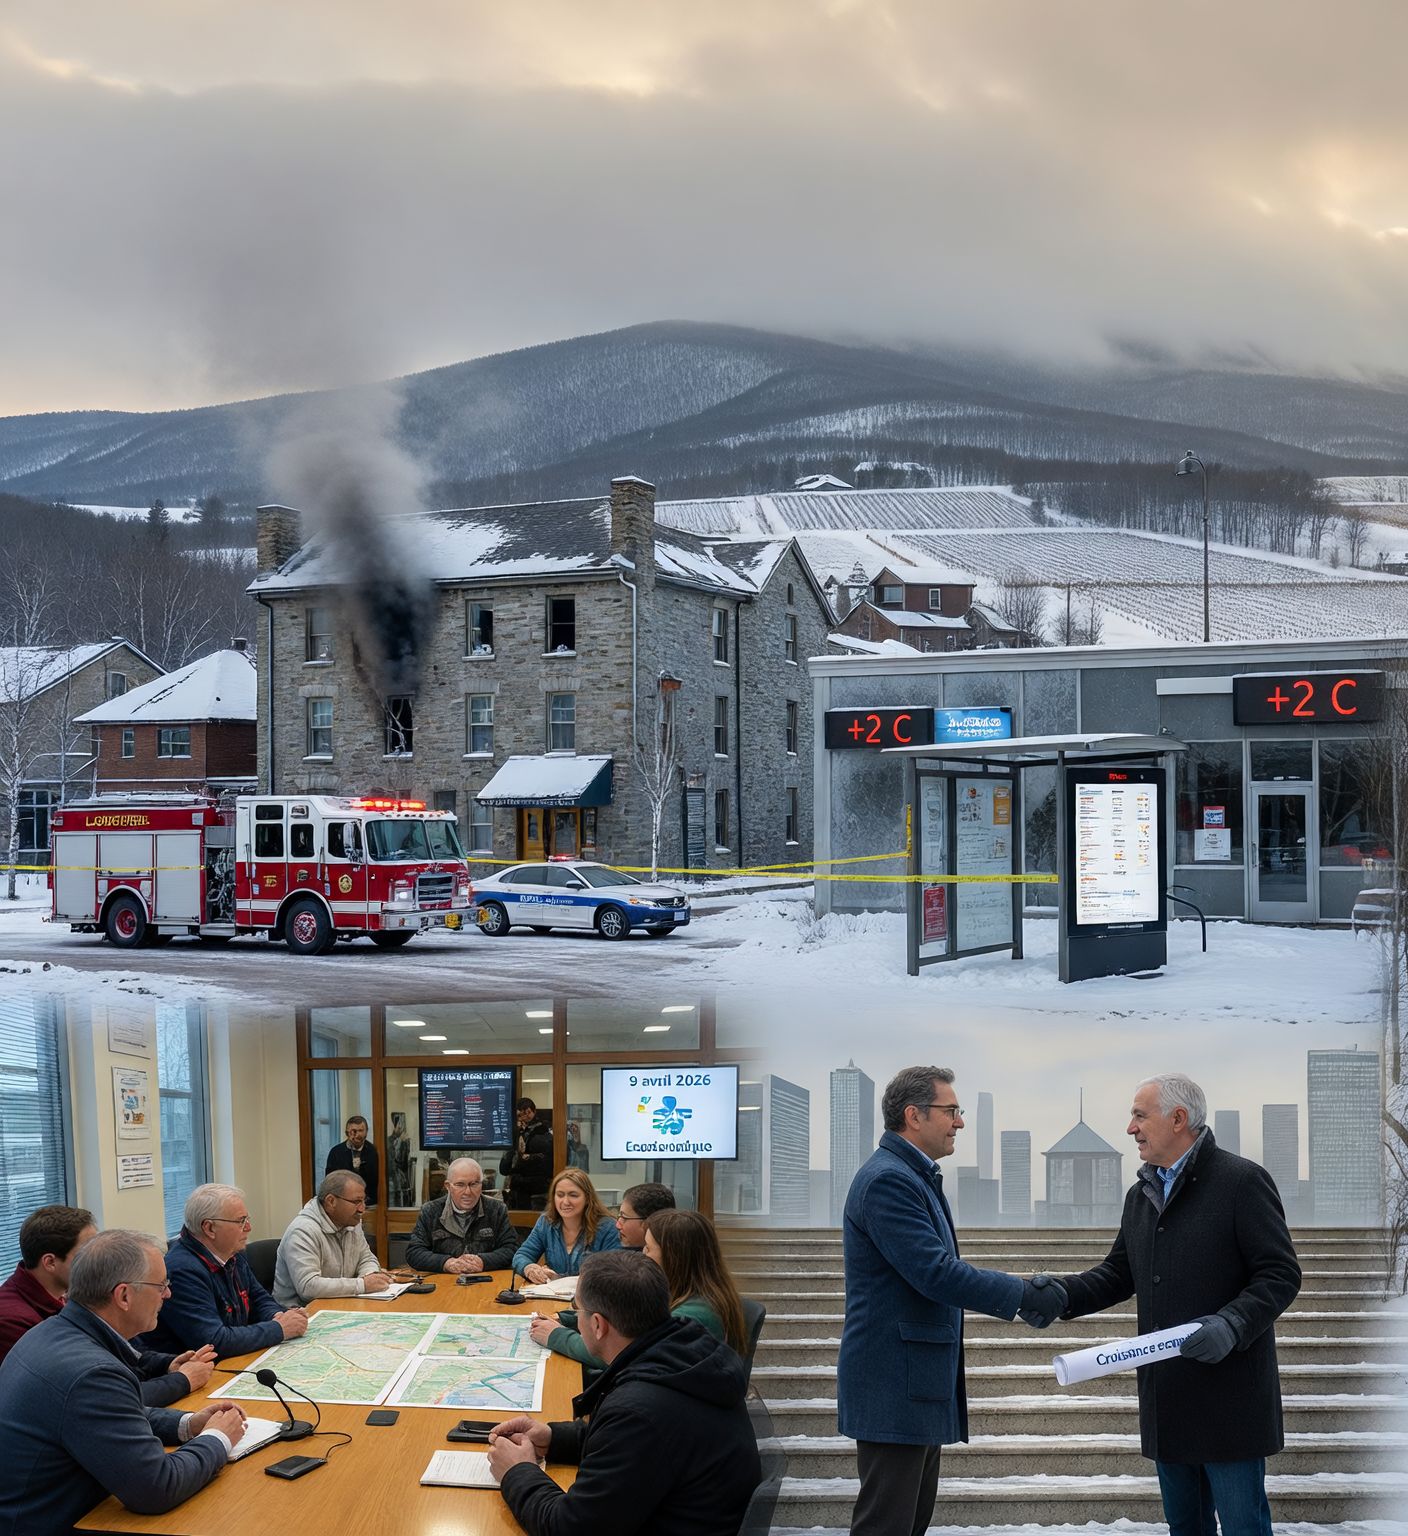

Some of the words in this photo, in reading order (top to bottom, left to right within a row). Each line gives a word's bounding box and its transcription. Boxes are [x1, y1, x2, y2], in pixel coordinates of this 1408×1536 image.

[1266, 680, 1315, 717] +2
[1331, 679, 1358, 715] C
[848, 714, 881, 744] +2
[892, 714, 912, 743] C
[629, 1075, 638, 1087] 9
[641, 1074, 672, 1087] avril
[675, 1074, 711, 1087] 2026
